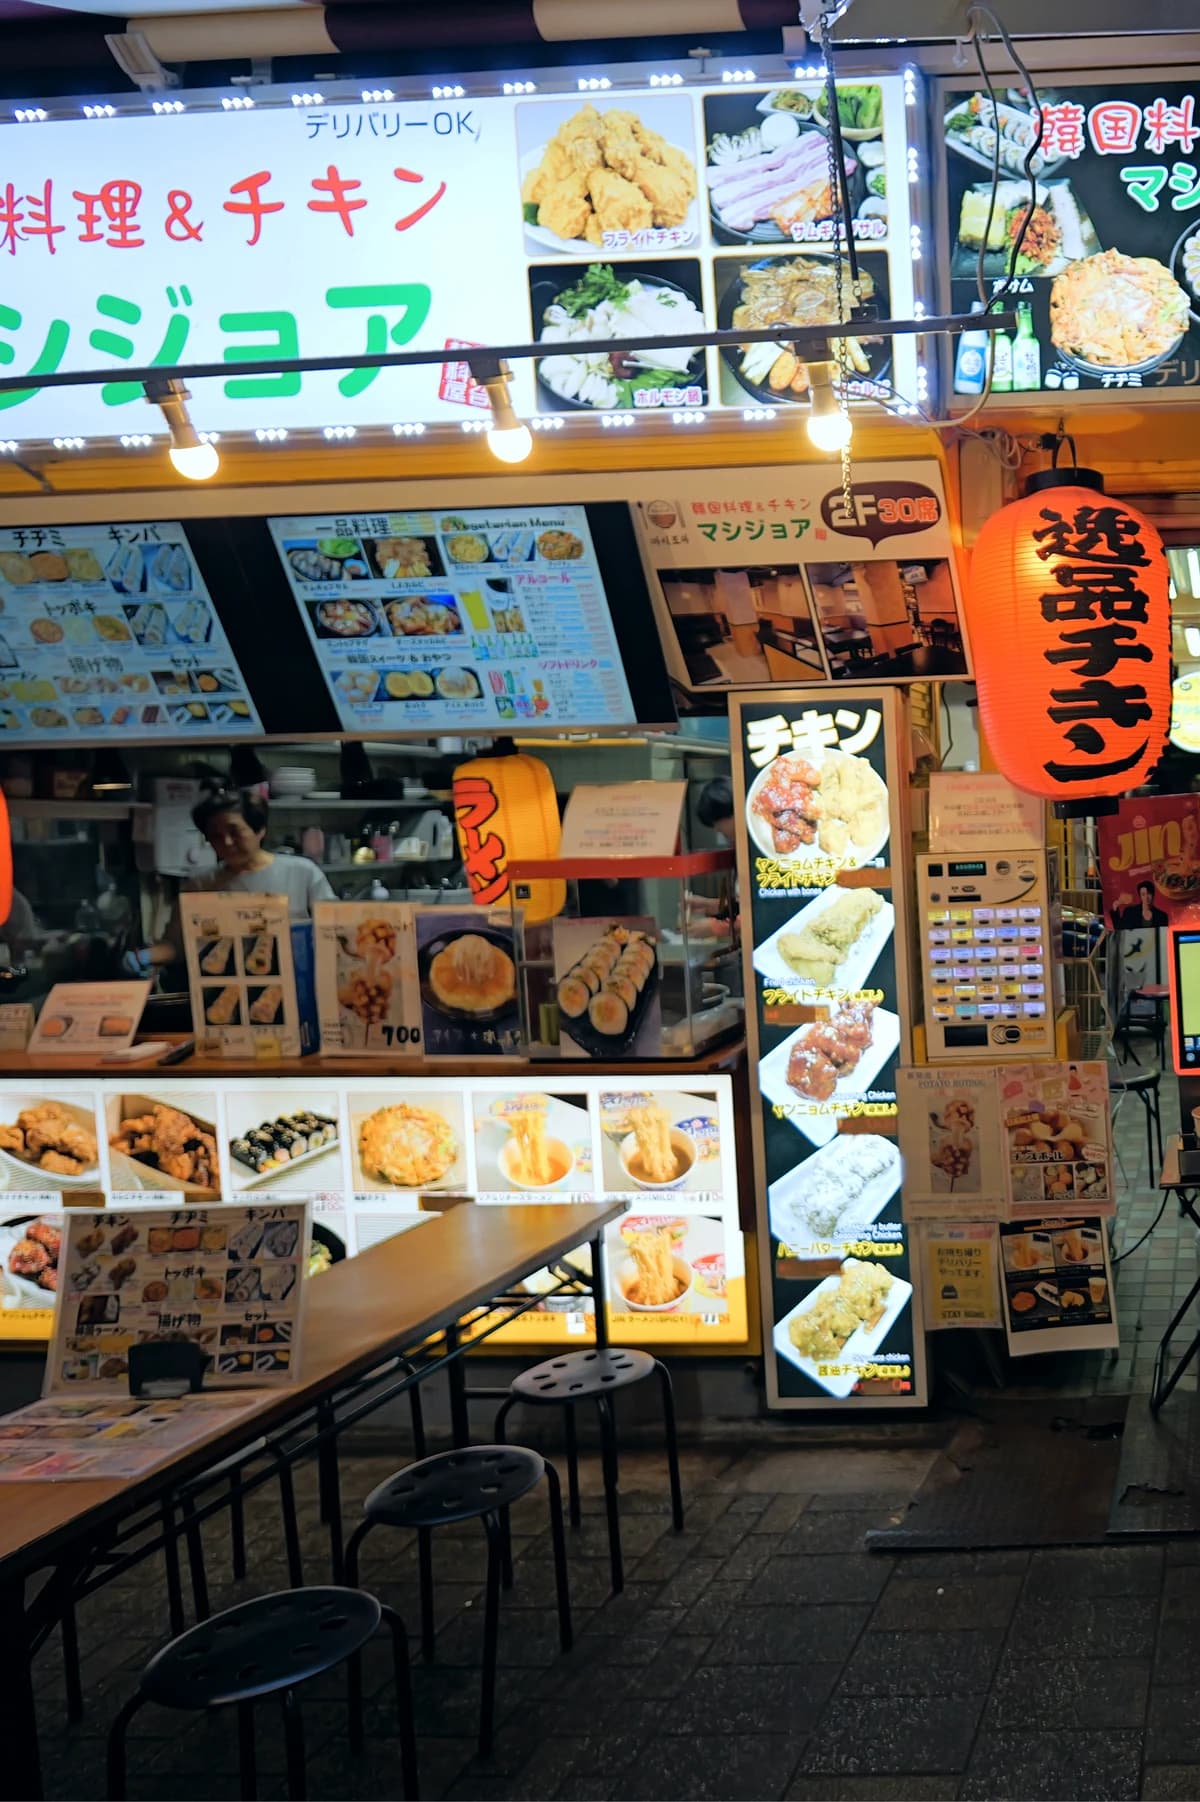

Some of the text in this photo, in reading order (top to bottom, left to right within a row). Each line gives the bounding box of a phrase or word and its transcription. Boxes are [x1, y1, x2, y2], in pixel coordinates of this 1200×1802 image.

[306, 111, 474, 141] デリバリーOK
[603, 226, 695, 251] フライドチキン
[315, 518, 392, 536] 一品料理
[697, 518, 811, 542] マシジョア
[1033, 506, 1154, 782] 逸品チキン
[747, 708, 883, 768] チキン
[755, 857, 846, 872] ヤンニョムチキン
[759, 888, 822, 897] Chicken with bones
[382, 1025, 420, 1046] 700
[868, 1090, 896, 1100] Chicken
[878, 1221, 902, 1231] butter
[833, 1231, 902, 1242] Seasoning Chicken
